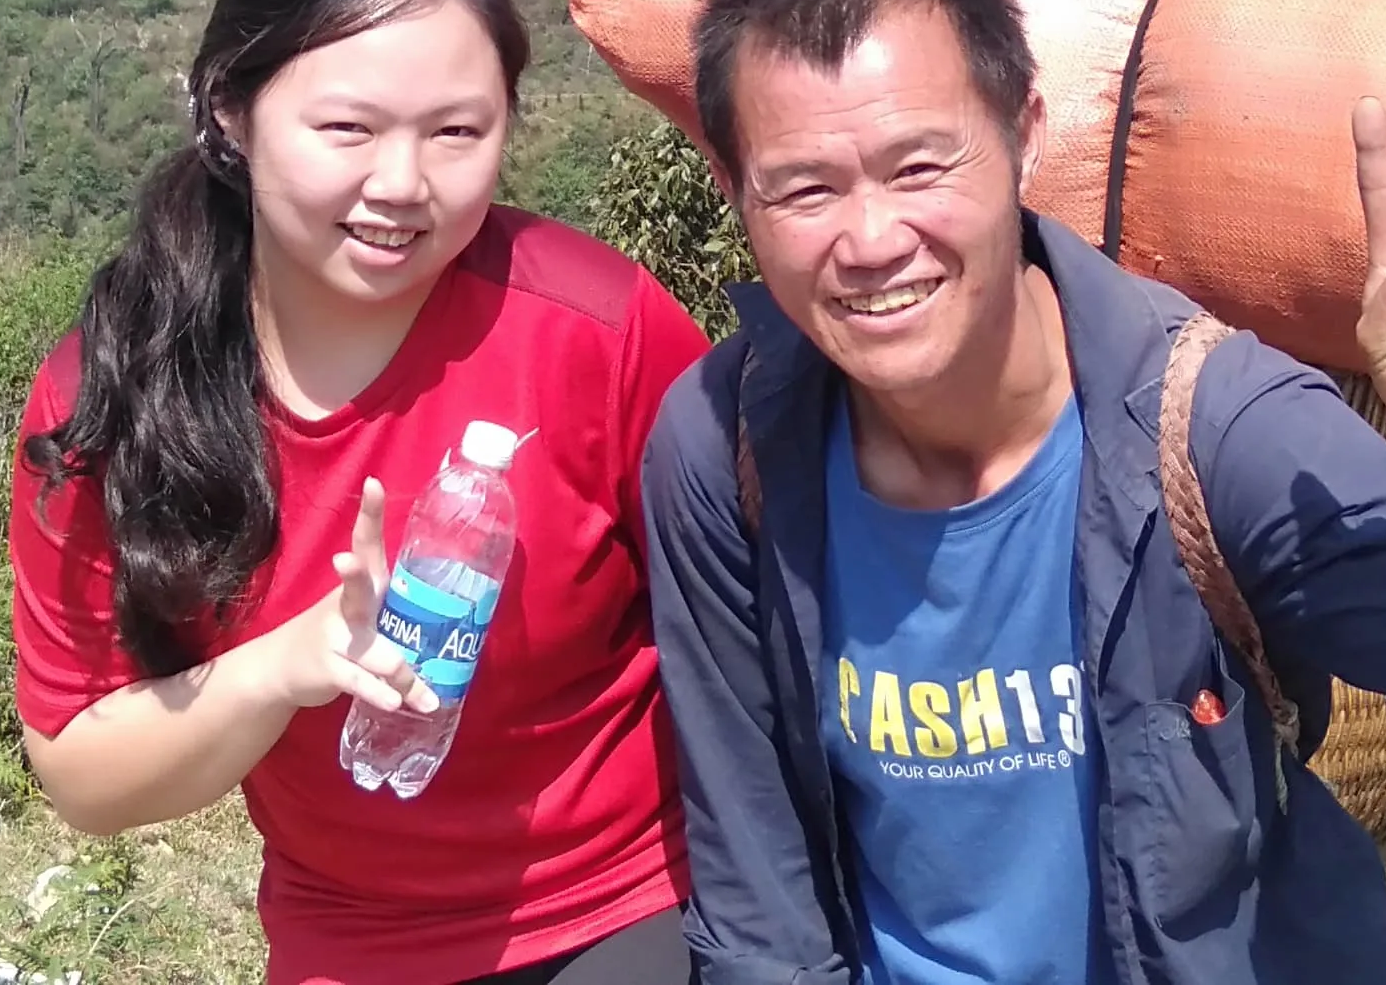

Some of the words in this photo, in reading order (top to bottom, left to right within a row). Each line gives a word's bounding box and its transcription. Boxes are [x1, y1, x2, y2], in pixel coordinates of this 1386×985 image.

[879, 760, 924, 779] YOUR
[927, 757, 996, 780] QUALITY
[999, 754, 1024, 771] OF
